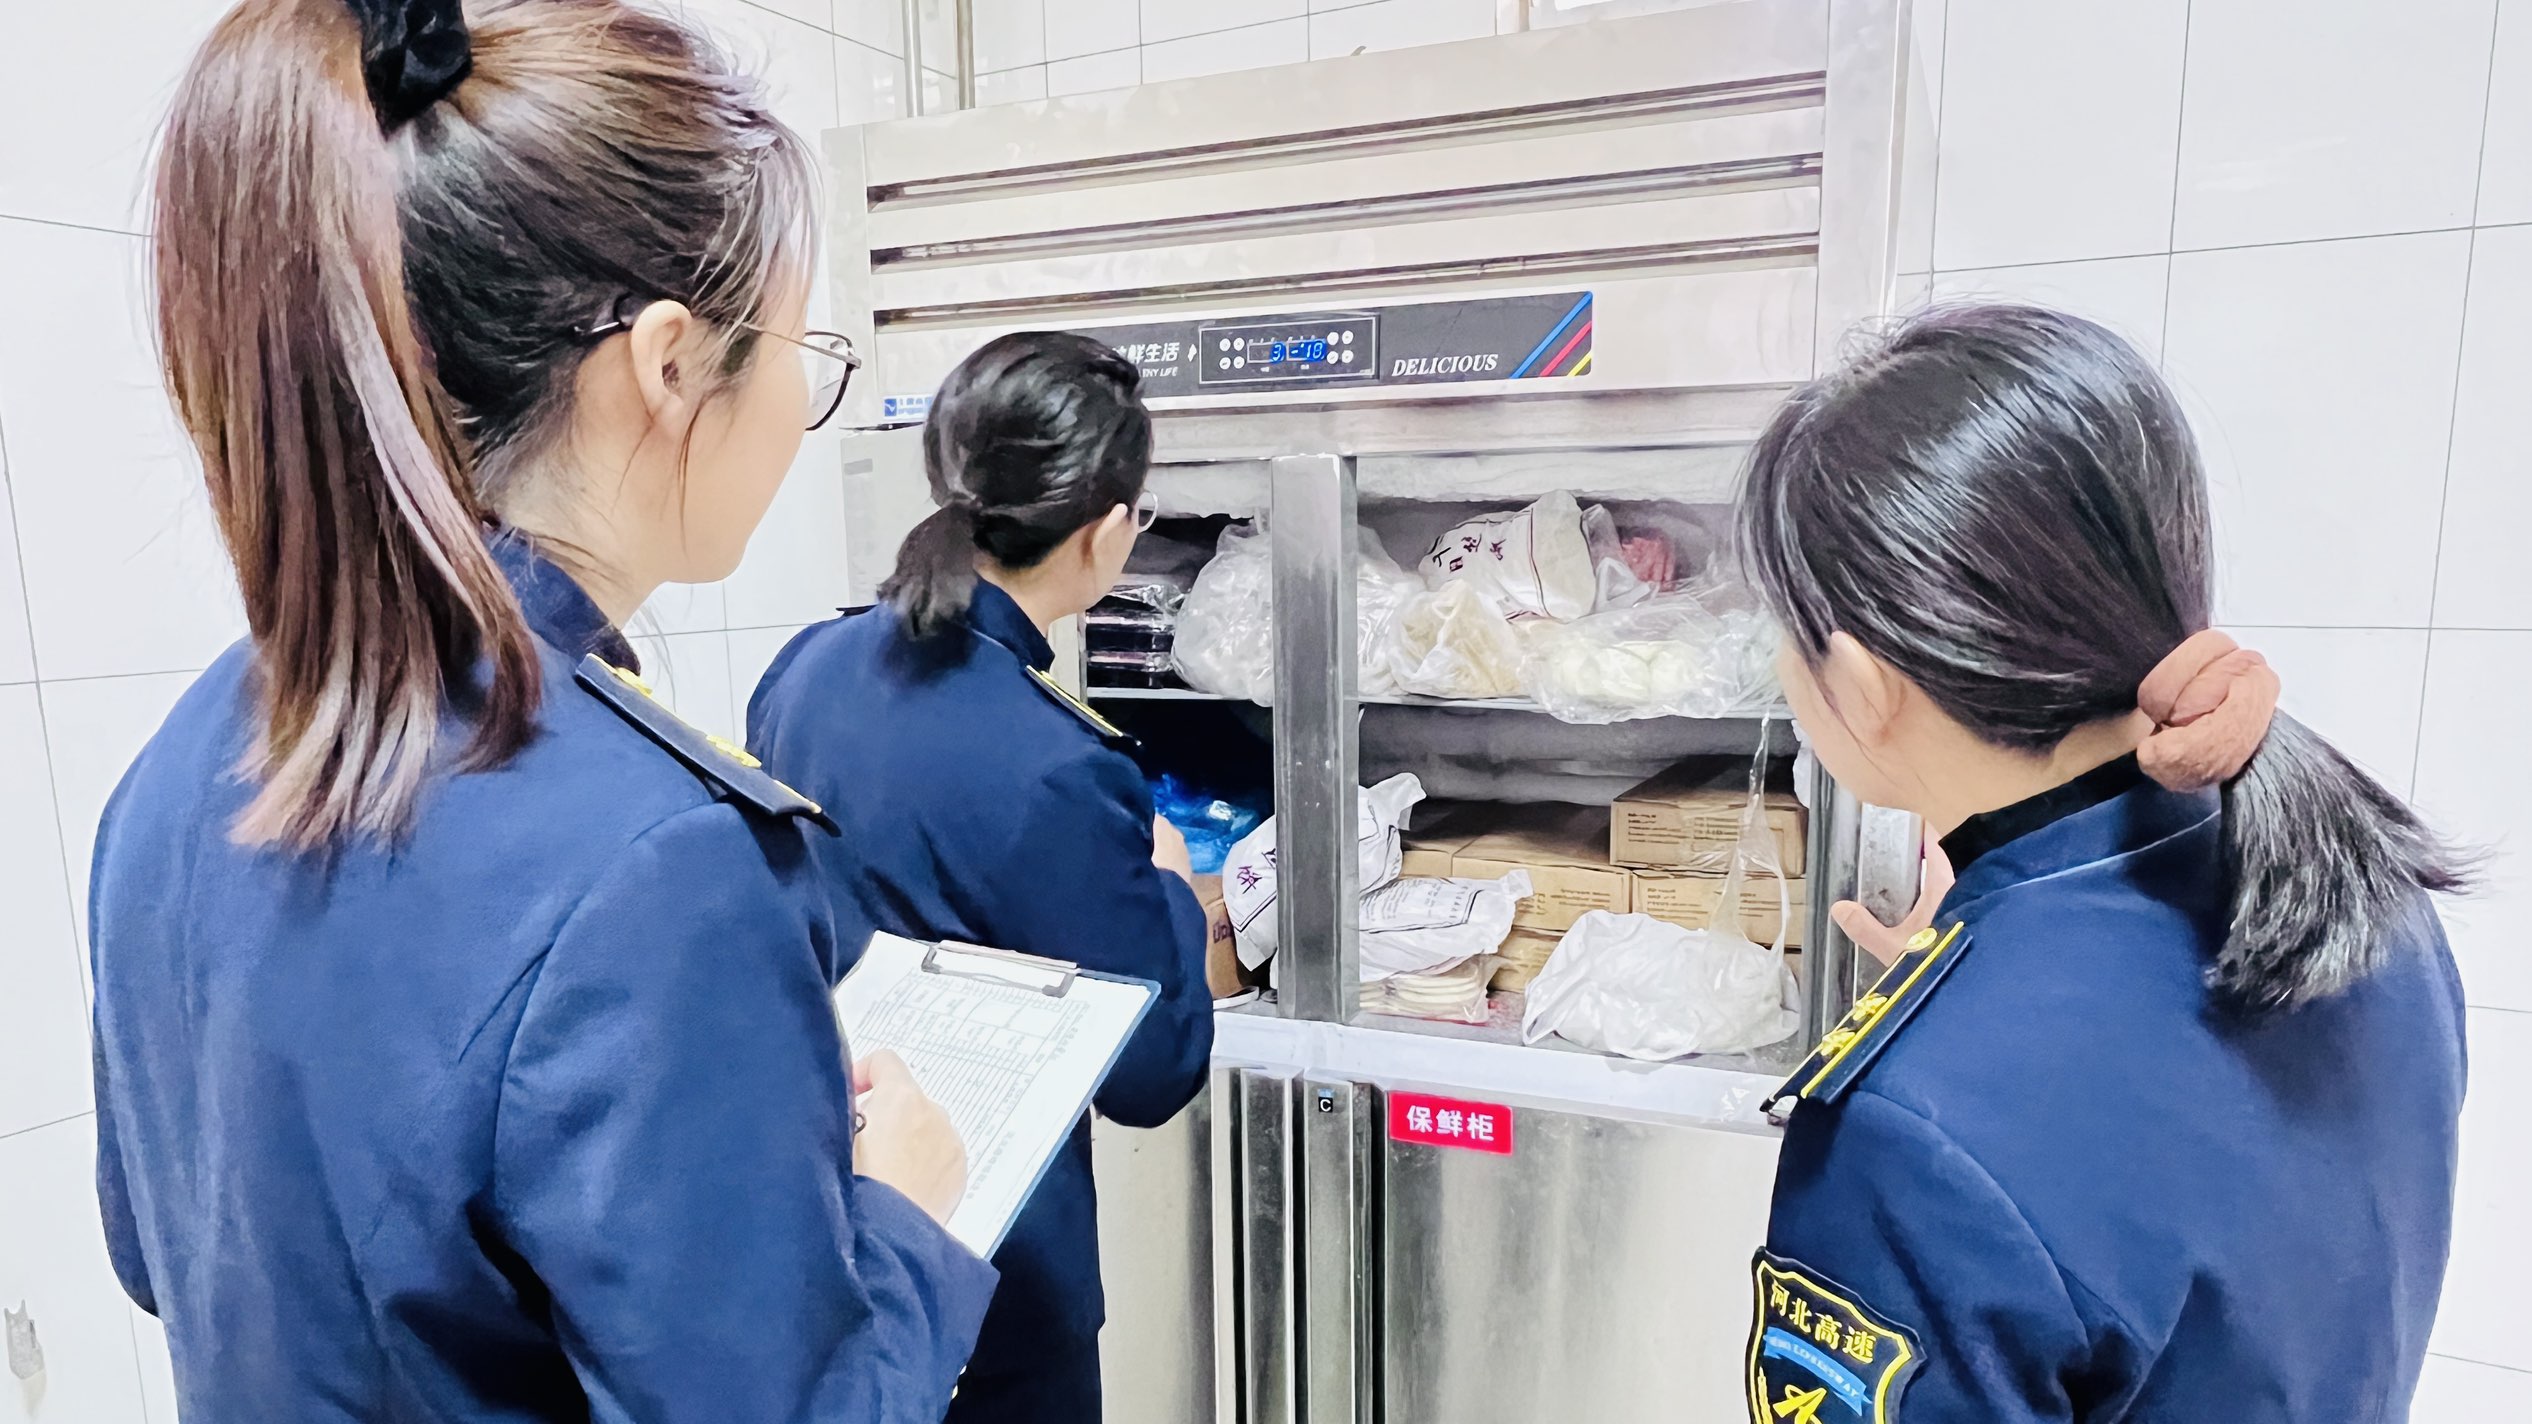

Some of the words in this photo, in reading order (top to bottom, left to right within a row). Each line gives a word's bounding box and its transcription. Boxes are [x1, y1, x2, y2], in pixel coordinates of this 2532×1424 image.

[1391, 354, 1499, 376] DELICIOUS
[1319, 1098, 1333, 1113] C
[1406, 1104, 1495, 1142] 保鲜柜
[1770, 1279, 1877, 1364] 河北高速
